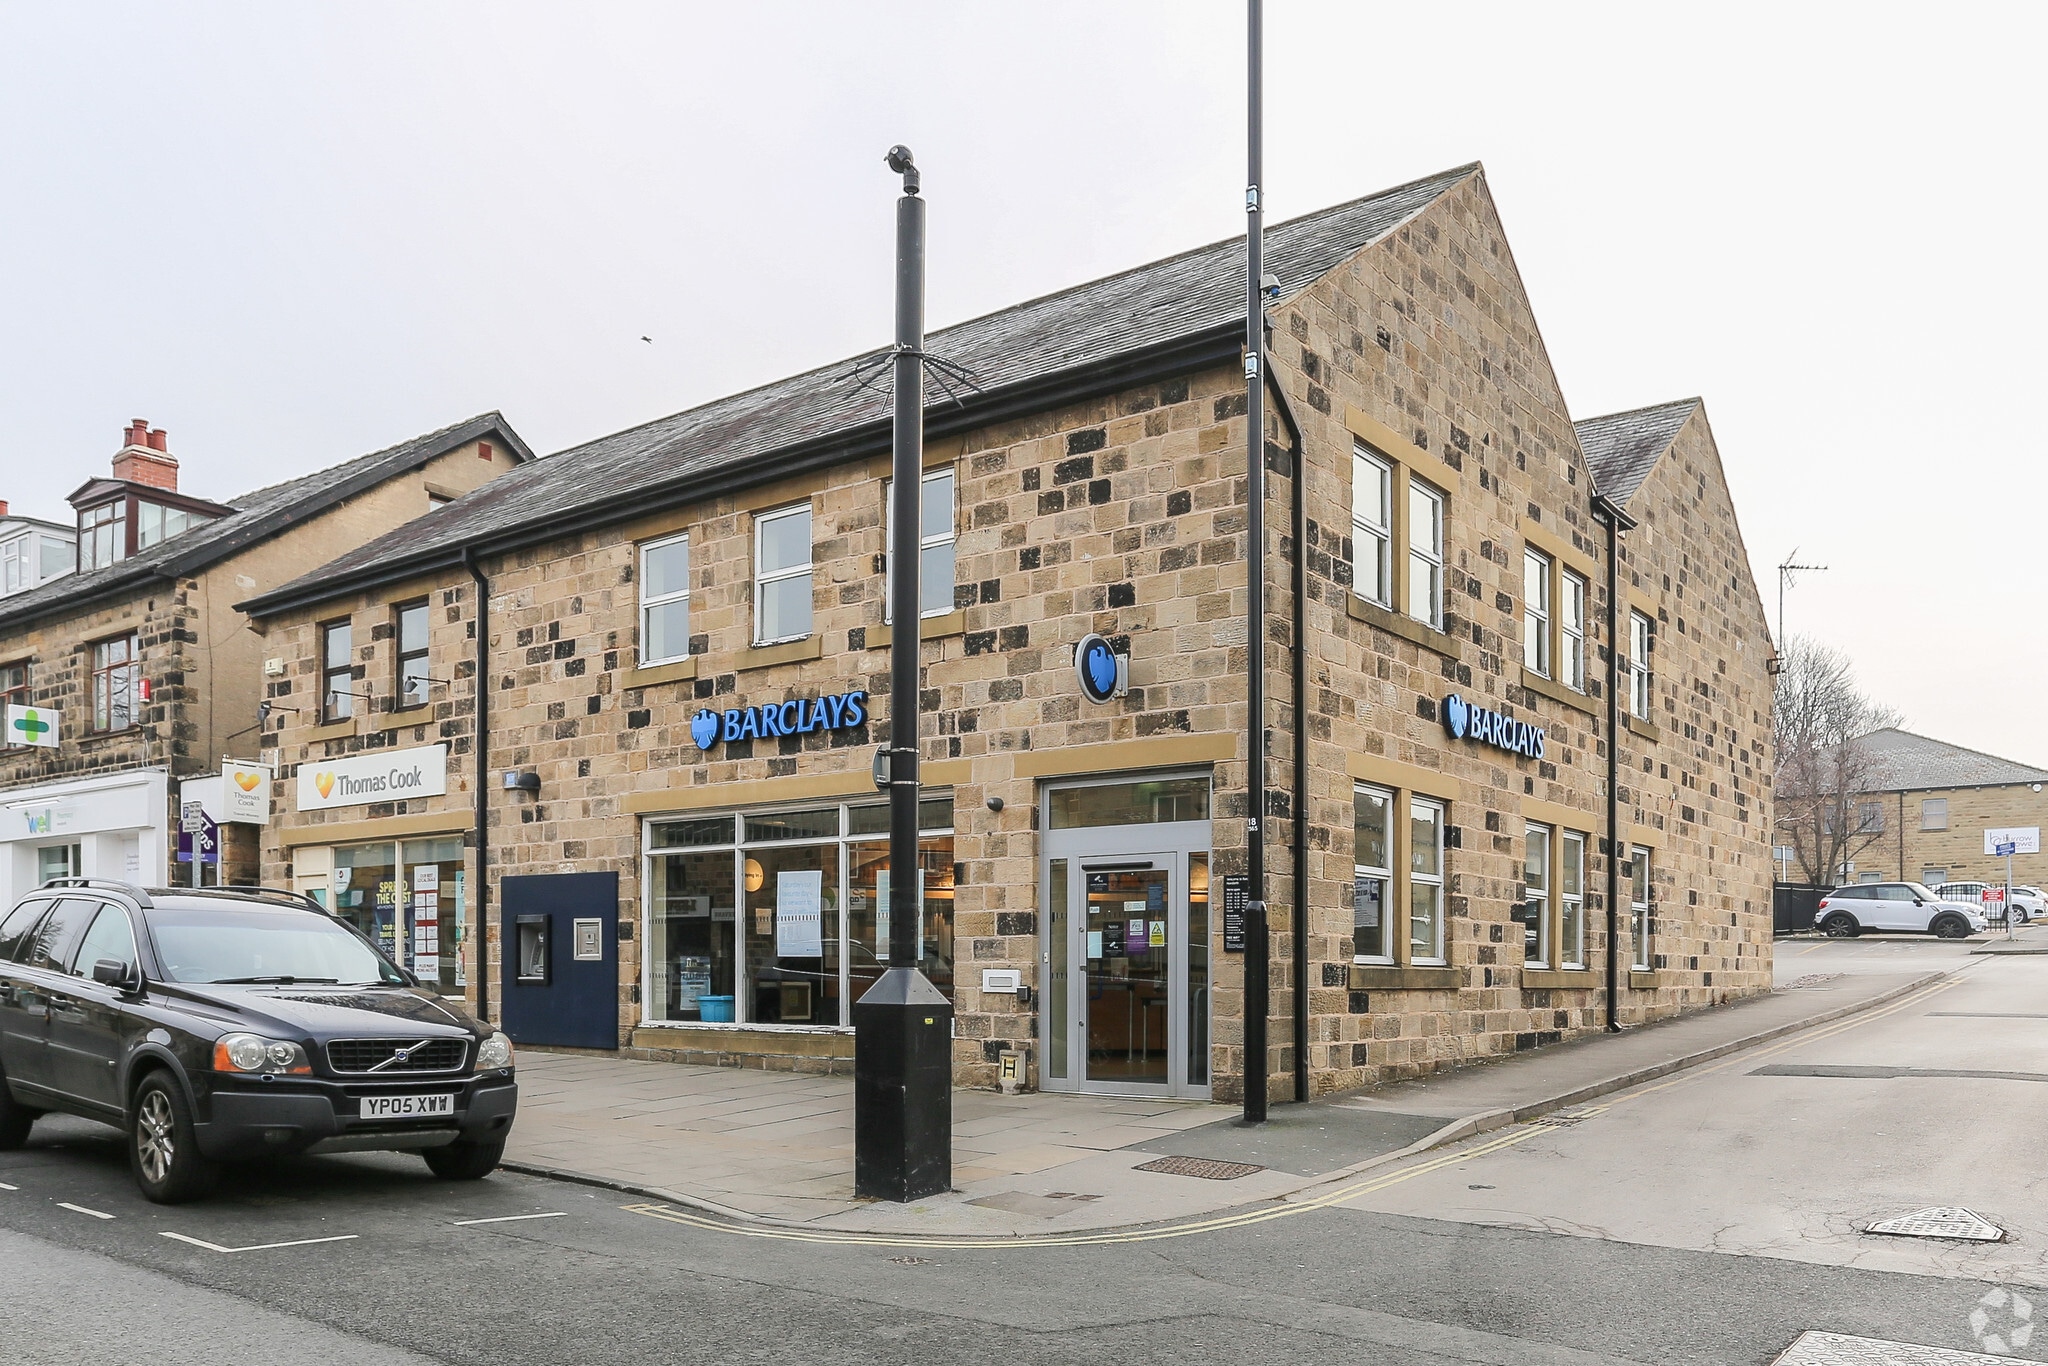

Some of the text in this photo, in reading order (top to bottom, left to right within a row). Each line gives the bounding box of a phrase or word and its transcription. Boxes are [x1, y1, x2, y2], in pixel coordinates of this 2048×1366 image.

[723, 691, 868, 742] BARCLAYS
[1470, 703, 1545, 759] BARCLAYS
[338, 765, 422, 795] Thomas Cook
[234, 792, 260, 801] Thomas
[376, 892, 411, 905] THE CST
[1003, 1059, 1016, 1078] H
[368, 1095, 447, 1115] YP05 XWW
